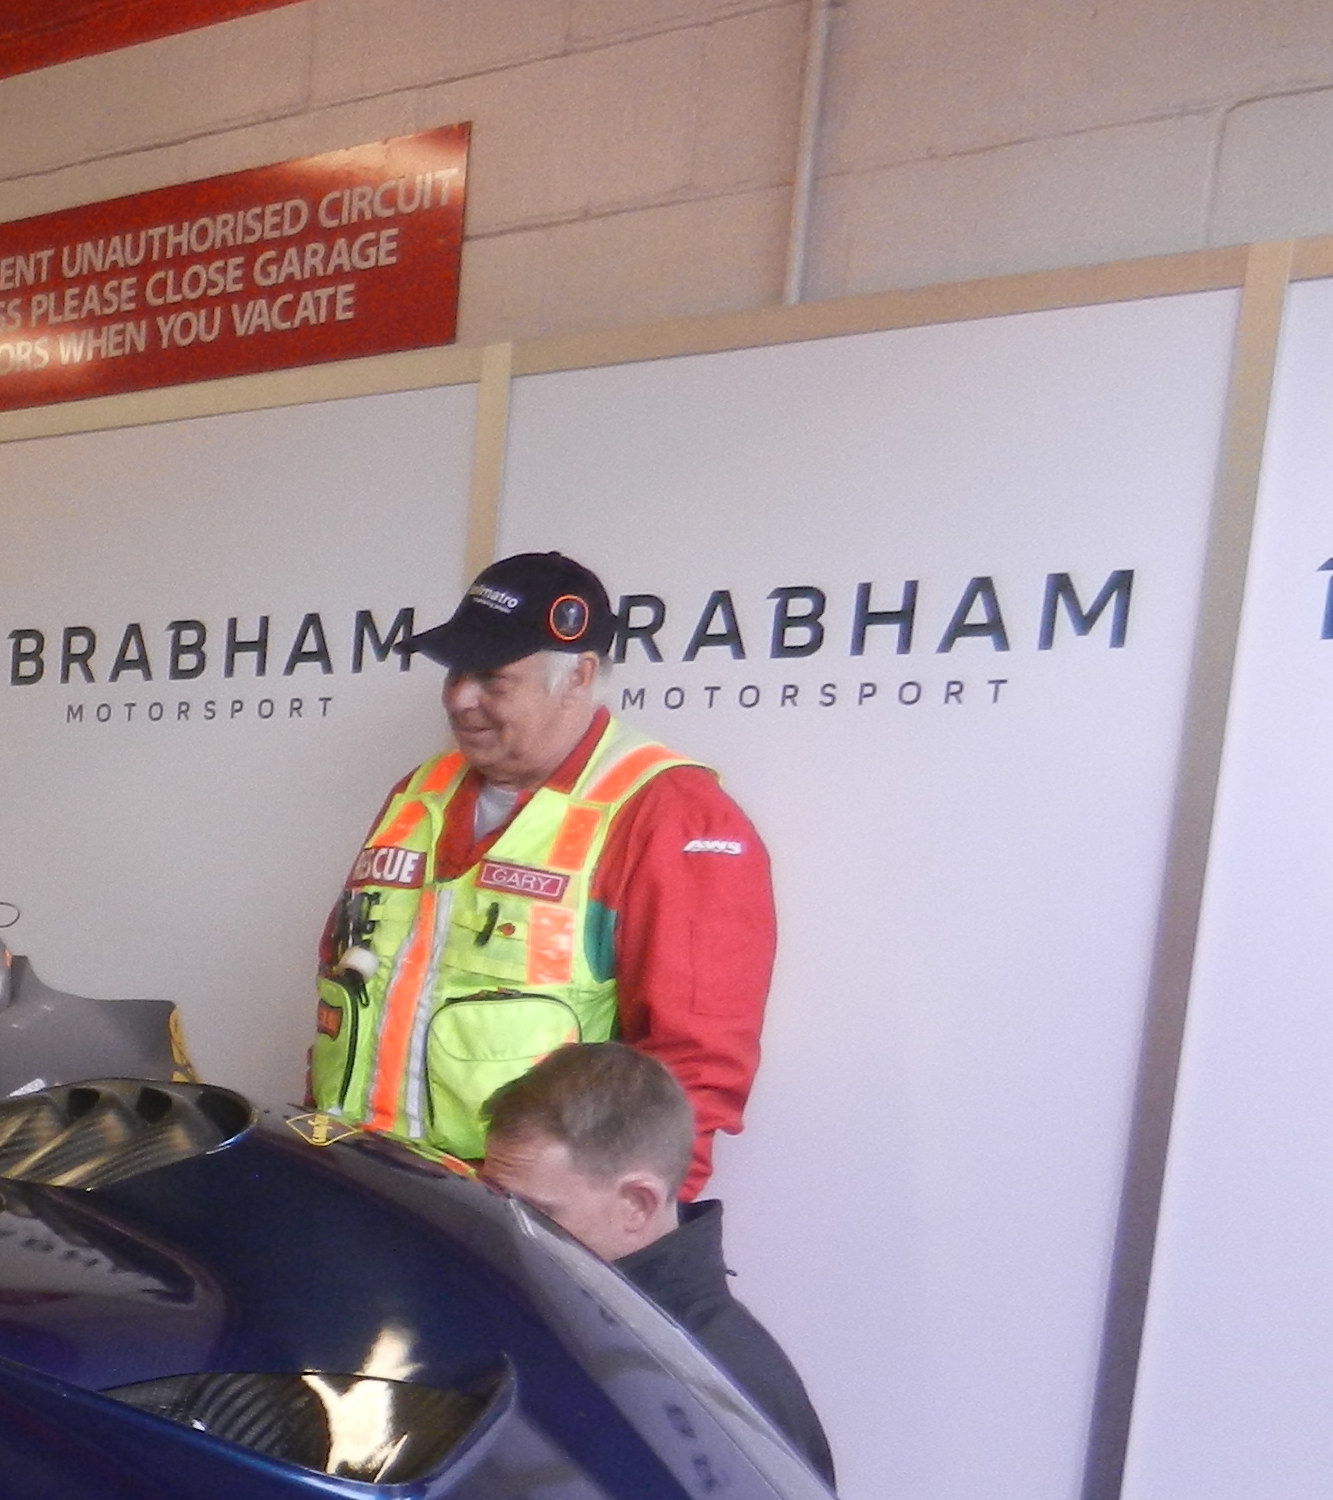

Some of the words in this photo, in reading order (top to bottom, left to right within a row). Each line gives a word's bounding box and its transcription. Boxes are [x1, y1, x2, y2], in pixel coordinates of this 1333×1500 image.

[62, 199, 308, 279] UNAUTHORISED
[318, 168, 459, 229] CIRCUIT
[31, 277, 137, 327] PLEASE
[145, 256, 245, 307] CLOSE
[253, 228, 400, 288] GARAGE
[58, 320, 146, 366] WHEN
[156, 306, 221, 348] YOU
[232, 283, 355, 337] VACATE
[8, 606, 418, 687] BRABHAM
[66, 696, 334, 724] MOTORSPORT
[622, 678, 1012, 712] MOTORSPORT
[491, 867, 554, 893] GARY
